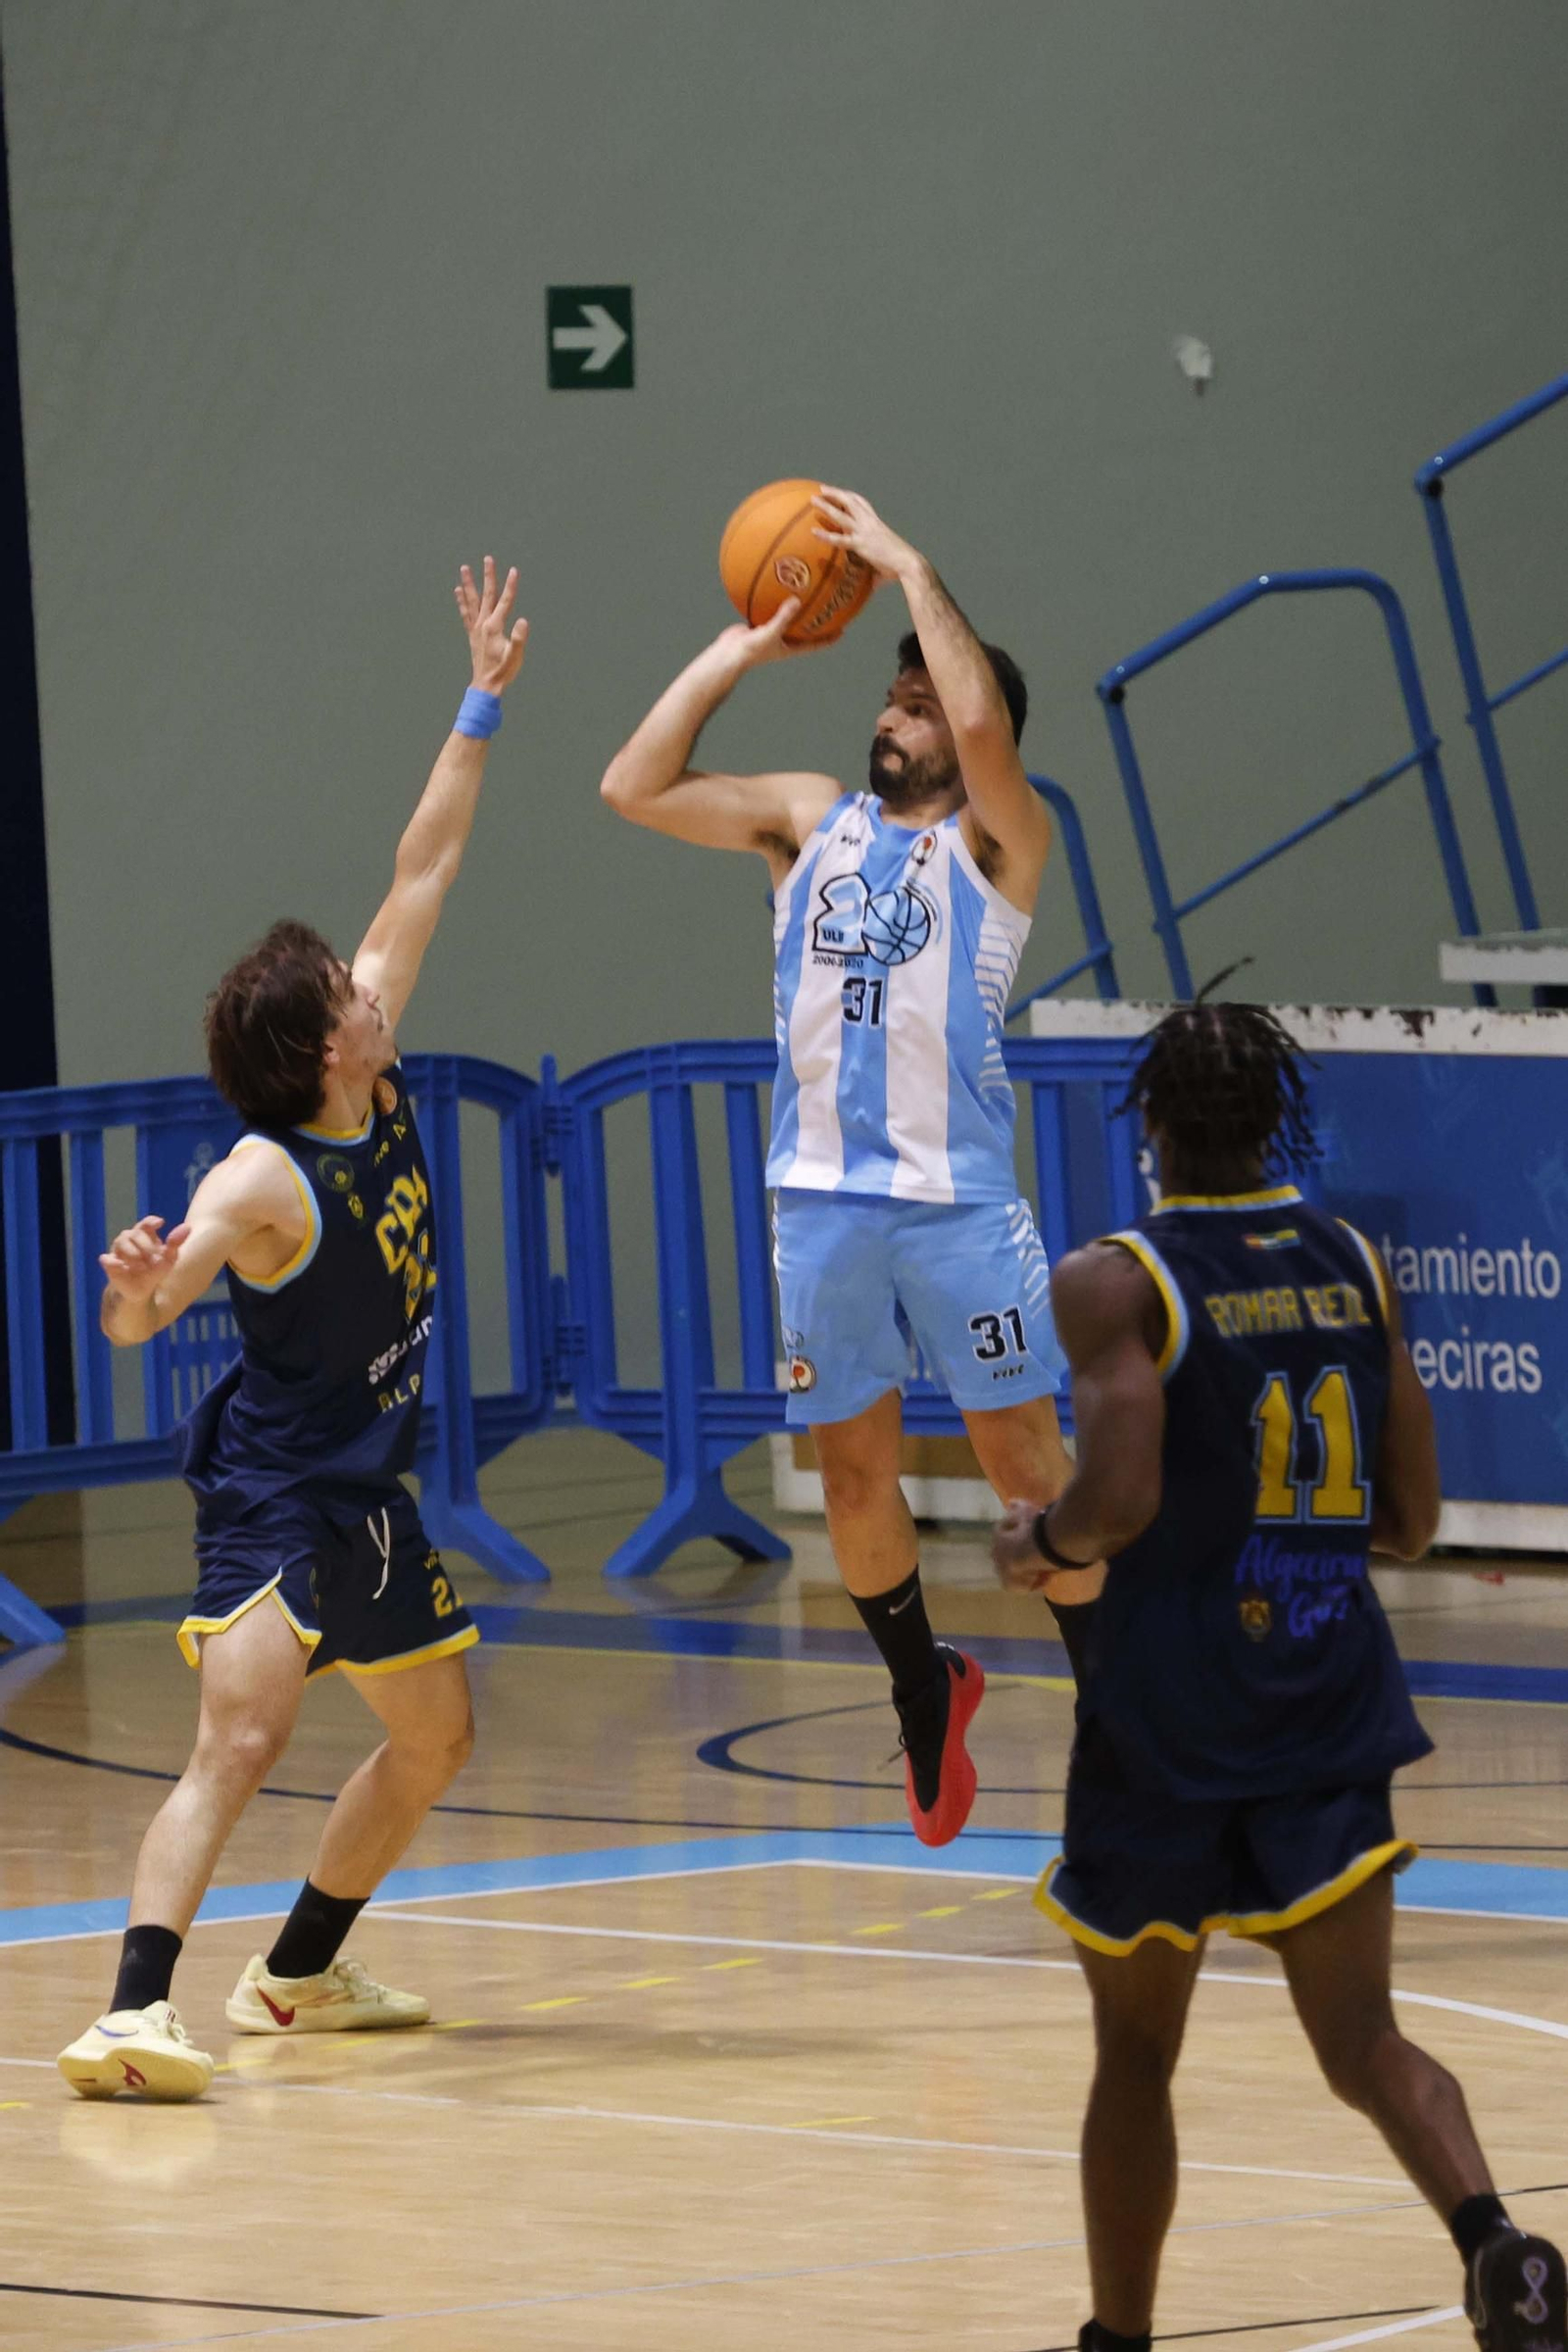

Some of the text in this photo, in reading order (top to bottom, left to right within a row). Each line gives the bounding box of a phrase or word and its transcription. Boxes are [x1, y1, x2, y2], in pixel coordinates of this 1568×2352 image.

[841, 976, 883, 1026] 31
[1382, 1233, 1561, 1298] tamiento
[967, 1304, 1029, 1363] 31
[1402, 1325, 1542, 1394] eciras
[1250, 1365, 1370, 1525] 11
[431, 1576, 465, 1618] 2
